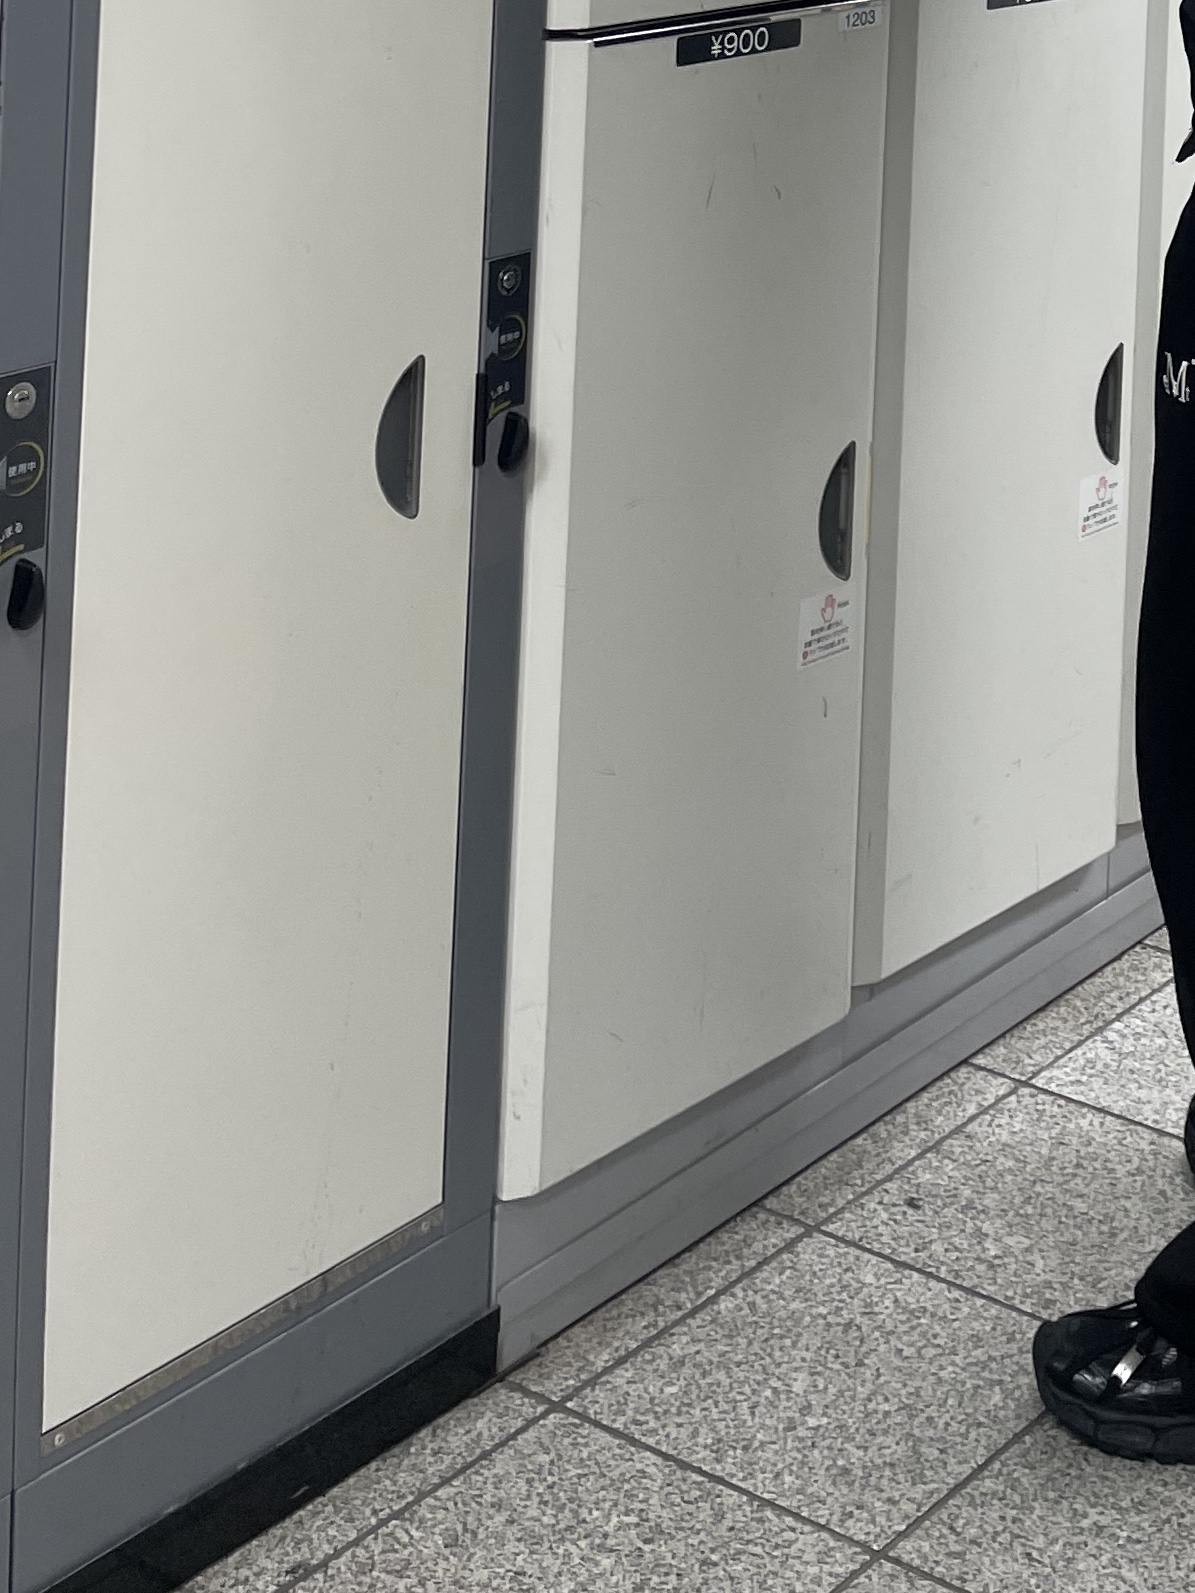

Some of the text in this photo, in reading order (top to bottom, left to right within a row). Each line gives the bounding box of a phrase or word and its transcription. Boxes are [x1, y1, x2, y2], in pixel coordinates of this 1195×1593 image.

[845, 9, 876, 28] 1203
[710, 26, 770, 58] ¥900
[8, 461, 37, 478] 使用中
